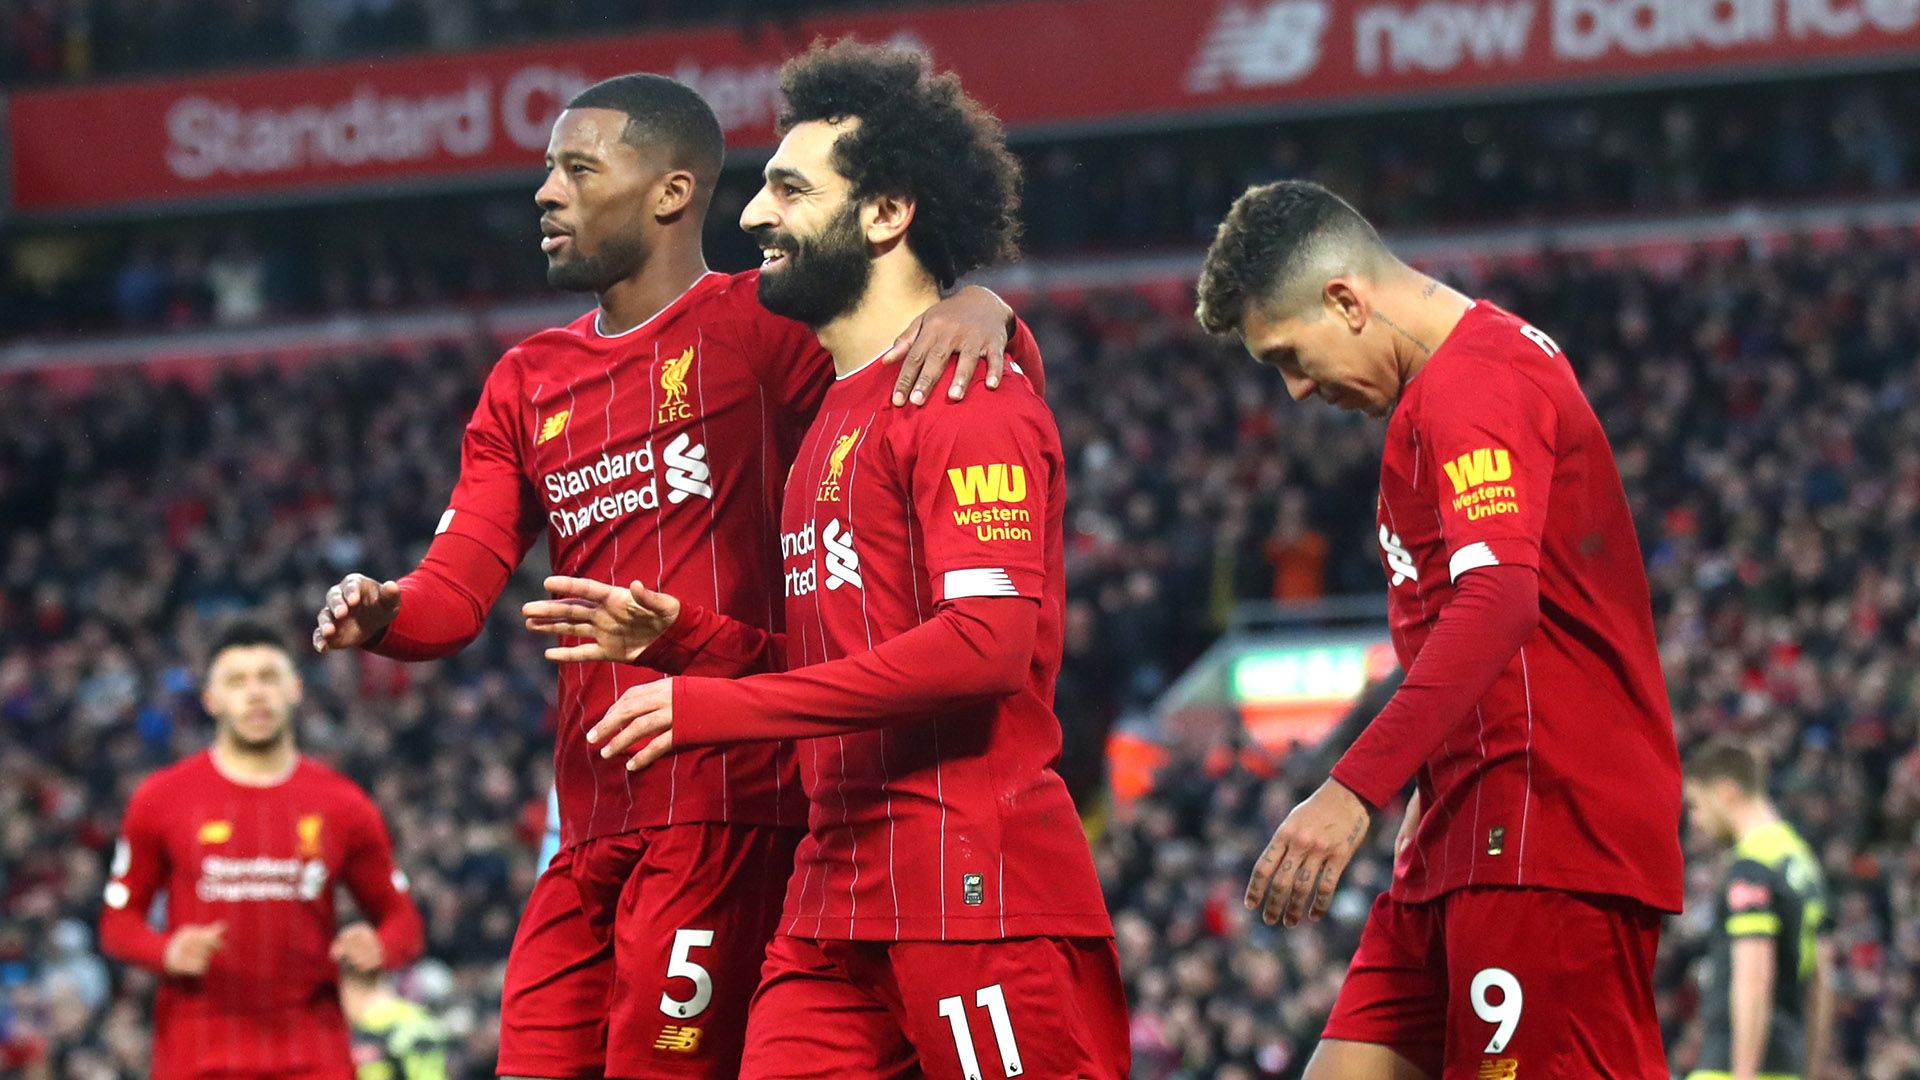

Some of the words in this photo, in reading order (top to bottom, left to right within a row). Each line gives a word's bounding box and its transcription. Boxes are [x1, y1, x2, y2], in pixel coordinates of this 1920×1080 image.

[1353, 2, 1536, 75] new
[166, 80, 492, 180] Standard
[544, 440, 654, 503] Standard
[947, 463, 1027, 506] WU
[1442, 447, 1513, 494] WU
[1452, 485, 1516, 513] Western
[549, 478, 659, 538] Chartered
[953, 505, 1030, 526] Western
[976, 523, 1032, 542] Union
[1466, 500, 1519, 521] Union
[659, 928, 715, 1019] 5
[937, 982, 1024, 1080] 11
[1470, 967, 1523, 1054] 9
